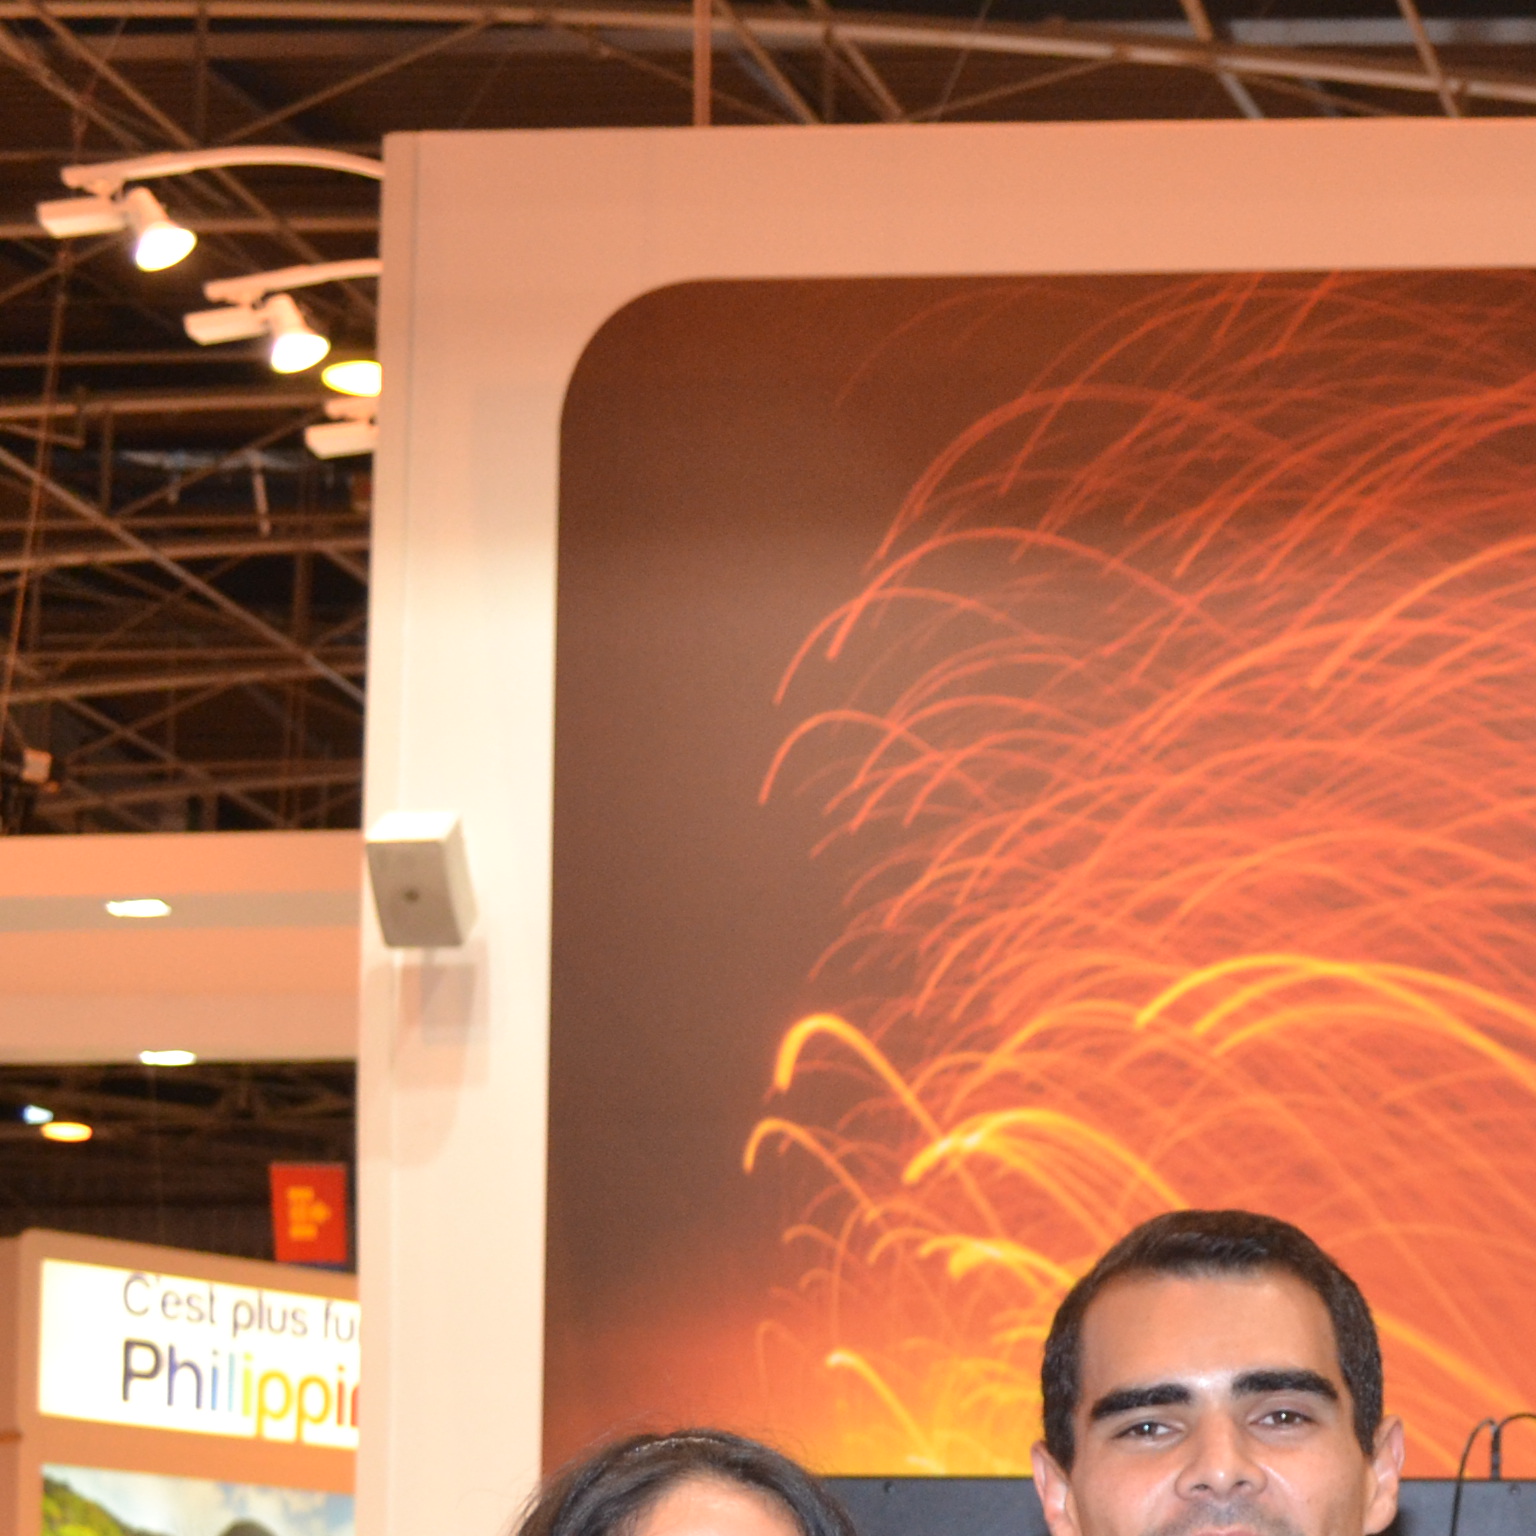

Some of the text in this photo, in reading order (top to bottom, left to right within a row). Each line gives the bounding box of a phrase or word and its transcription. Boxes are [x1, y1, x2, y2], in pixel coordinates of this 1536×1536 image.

[122, 1272, 361, 1344] C'est plus fu
[121, 1339, 360, 1440] Philippi
